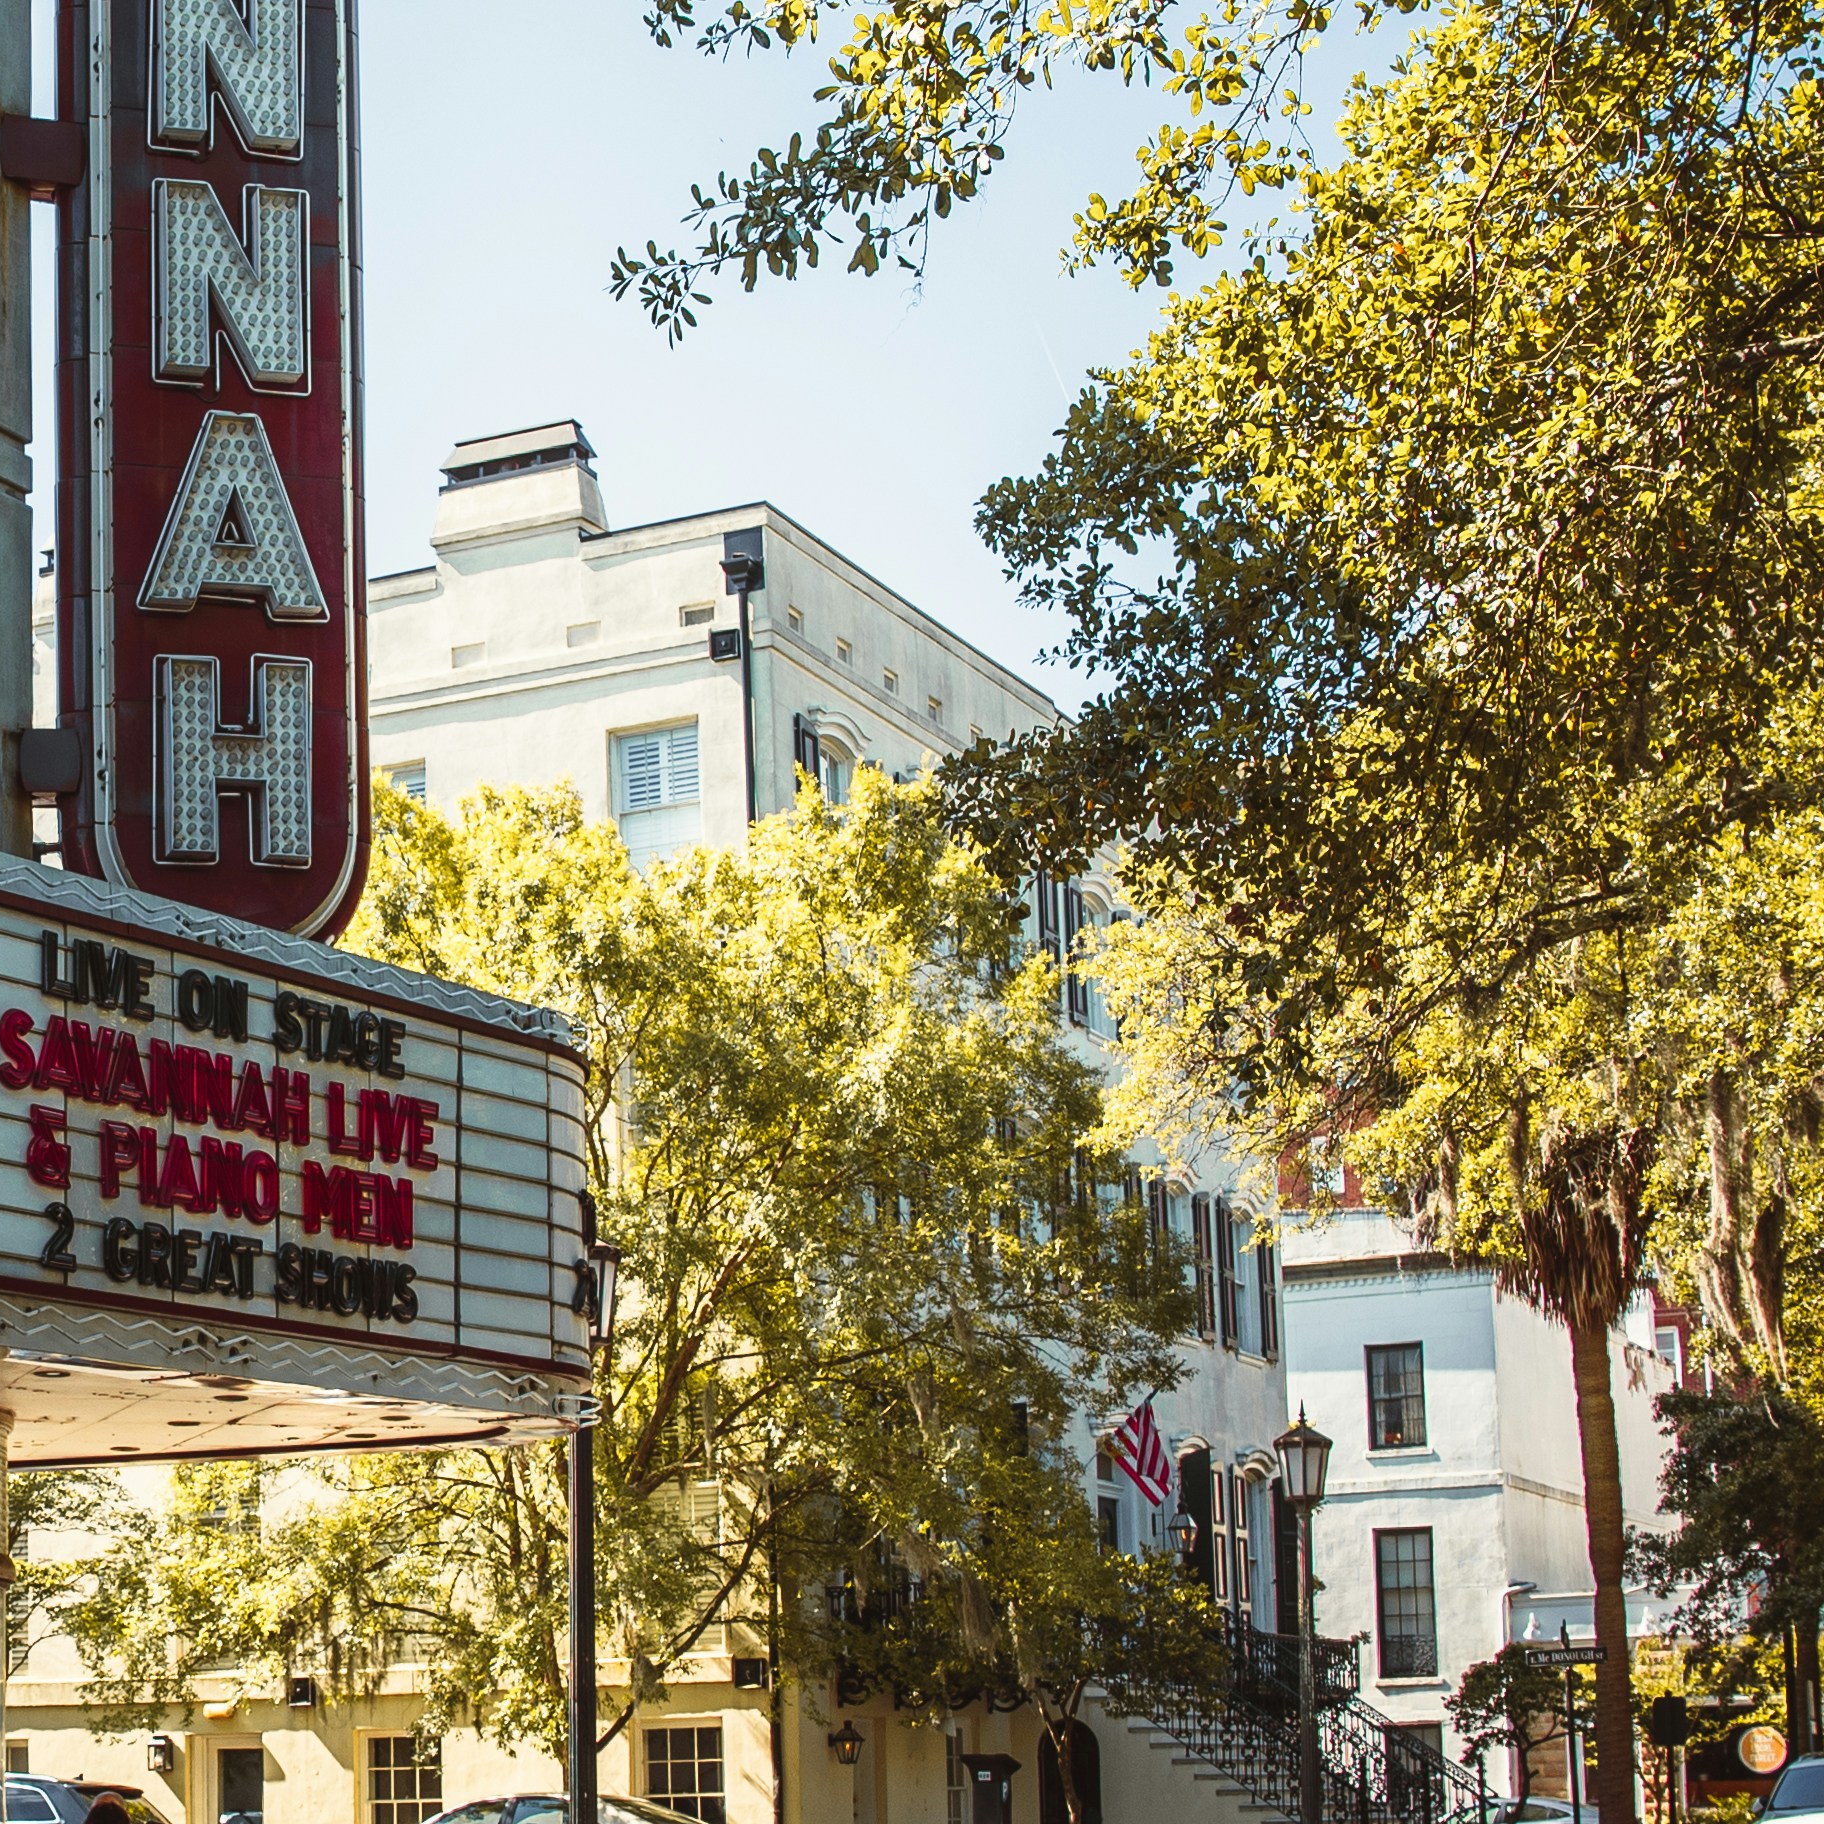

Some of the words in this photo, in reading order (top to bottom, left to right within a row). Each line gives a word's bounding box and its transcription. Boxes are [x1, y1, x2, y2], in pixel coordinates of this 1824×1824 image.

[41, 929, 155, 1022] LIVE
[177, 968, 250, 1044] ON
[272, 990, 407, 1080] STAGE
[27, 1103, 72, 1190] &
[99, 1118, 277, 1225] PIANO
[301, 1159, 414, 1250] MEN
[328, 1080, 440, 1171] LIVE
[40, 1201, 77, 1273] 2
[102, 1216, 264, 1301] GREAT
[273, 1242, 419, 1324] SHOWS
